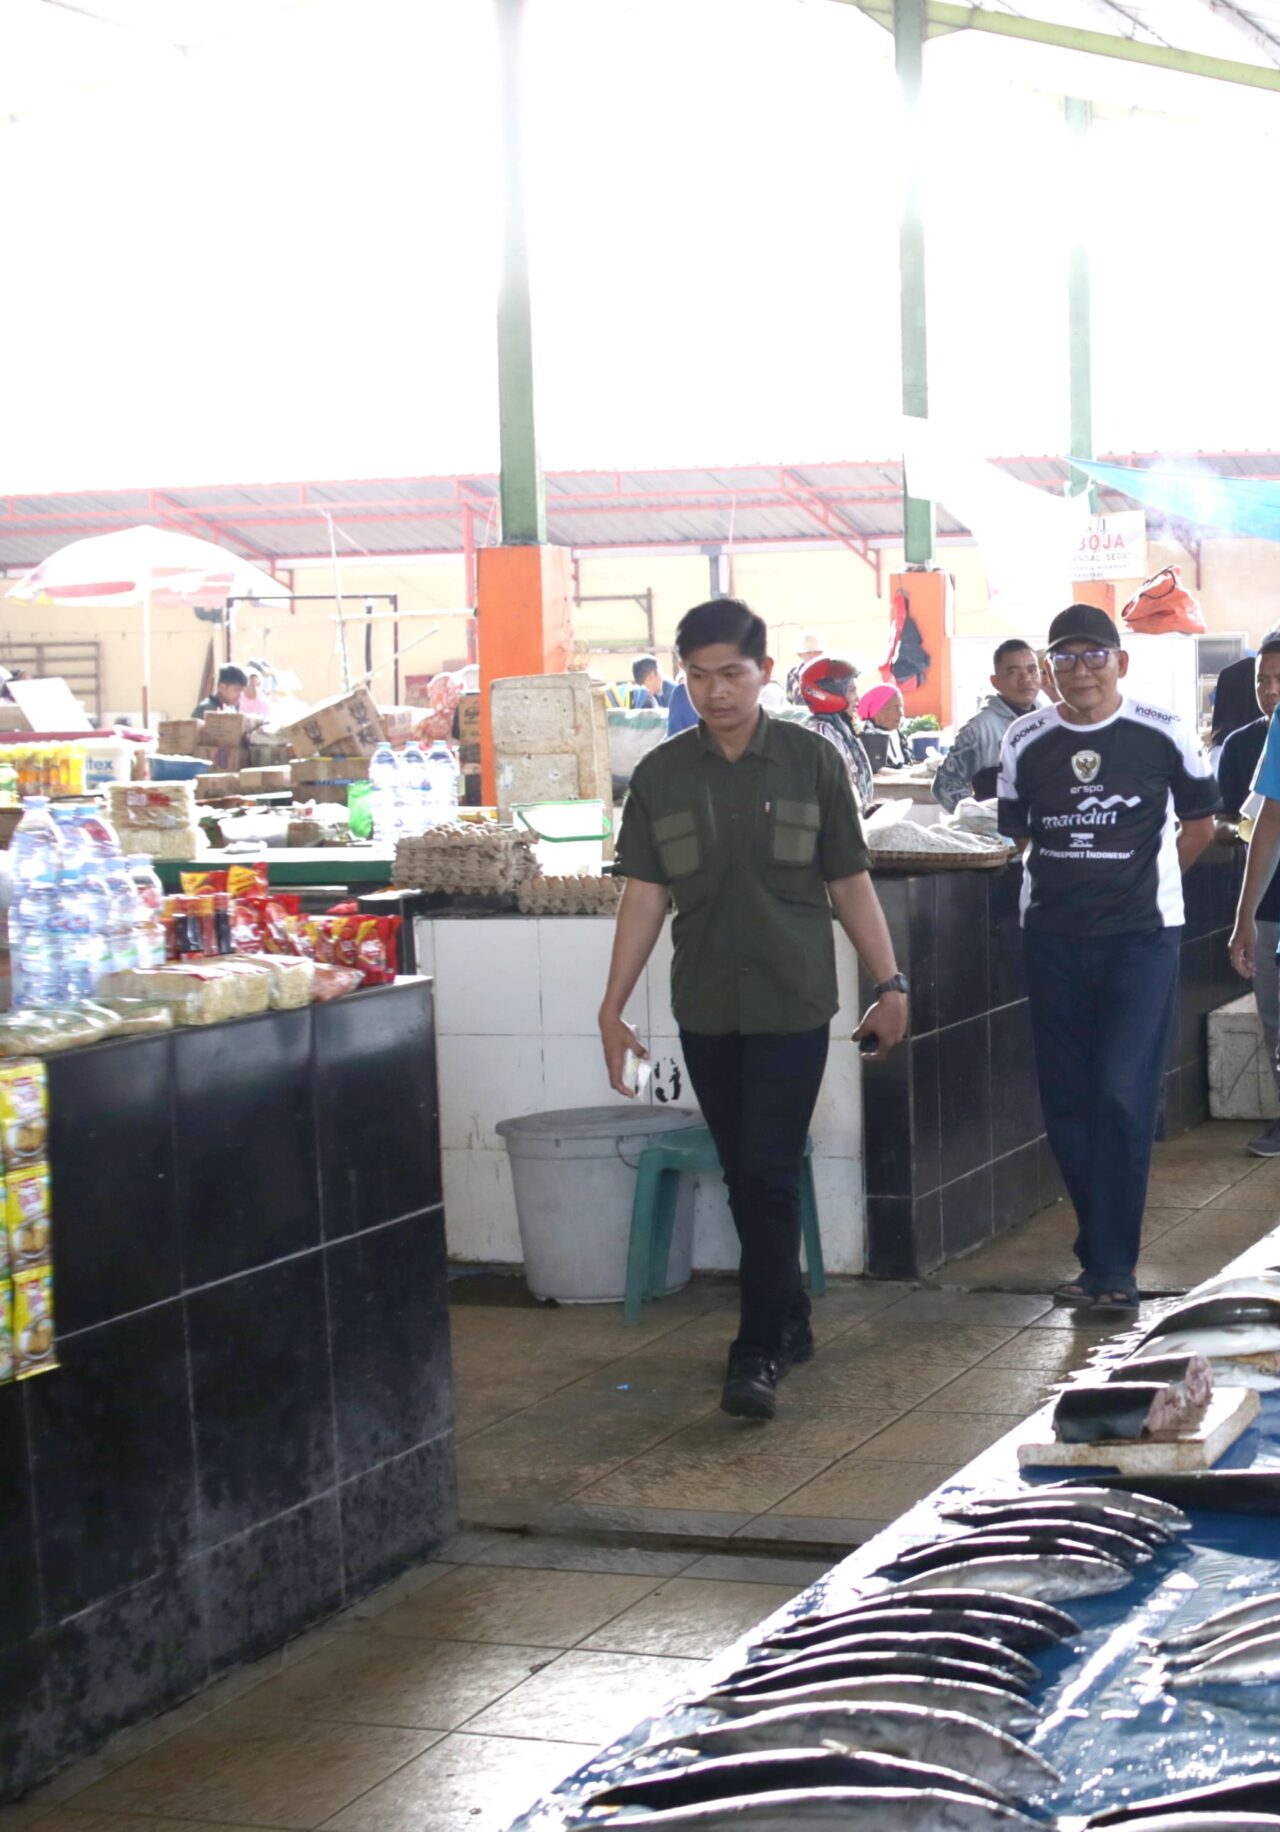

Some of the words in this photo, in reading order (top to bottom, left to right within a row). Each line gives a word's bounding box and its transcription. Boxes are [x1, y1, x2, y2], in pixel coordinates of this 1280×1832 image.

[1070, 784, 1104, 795] erspo
[1042, 808, 1118, 829] mandiri
[1086, 850, 1131, 860] INDONESIA
